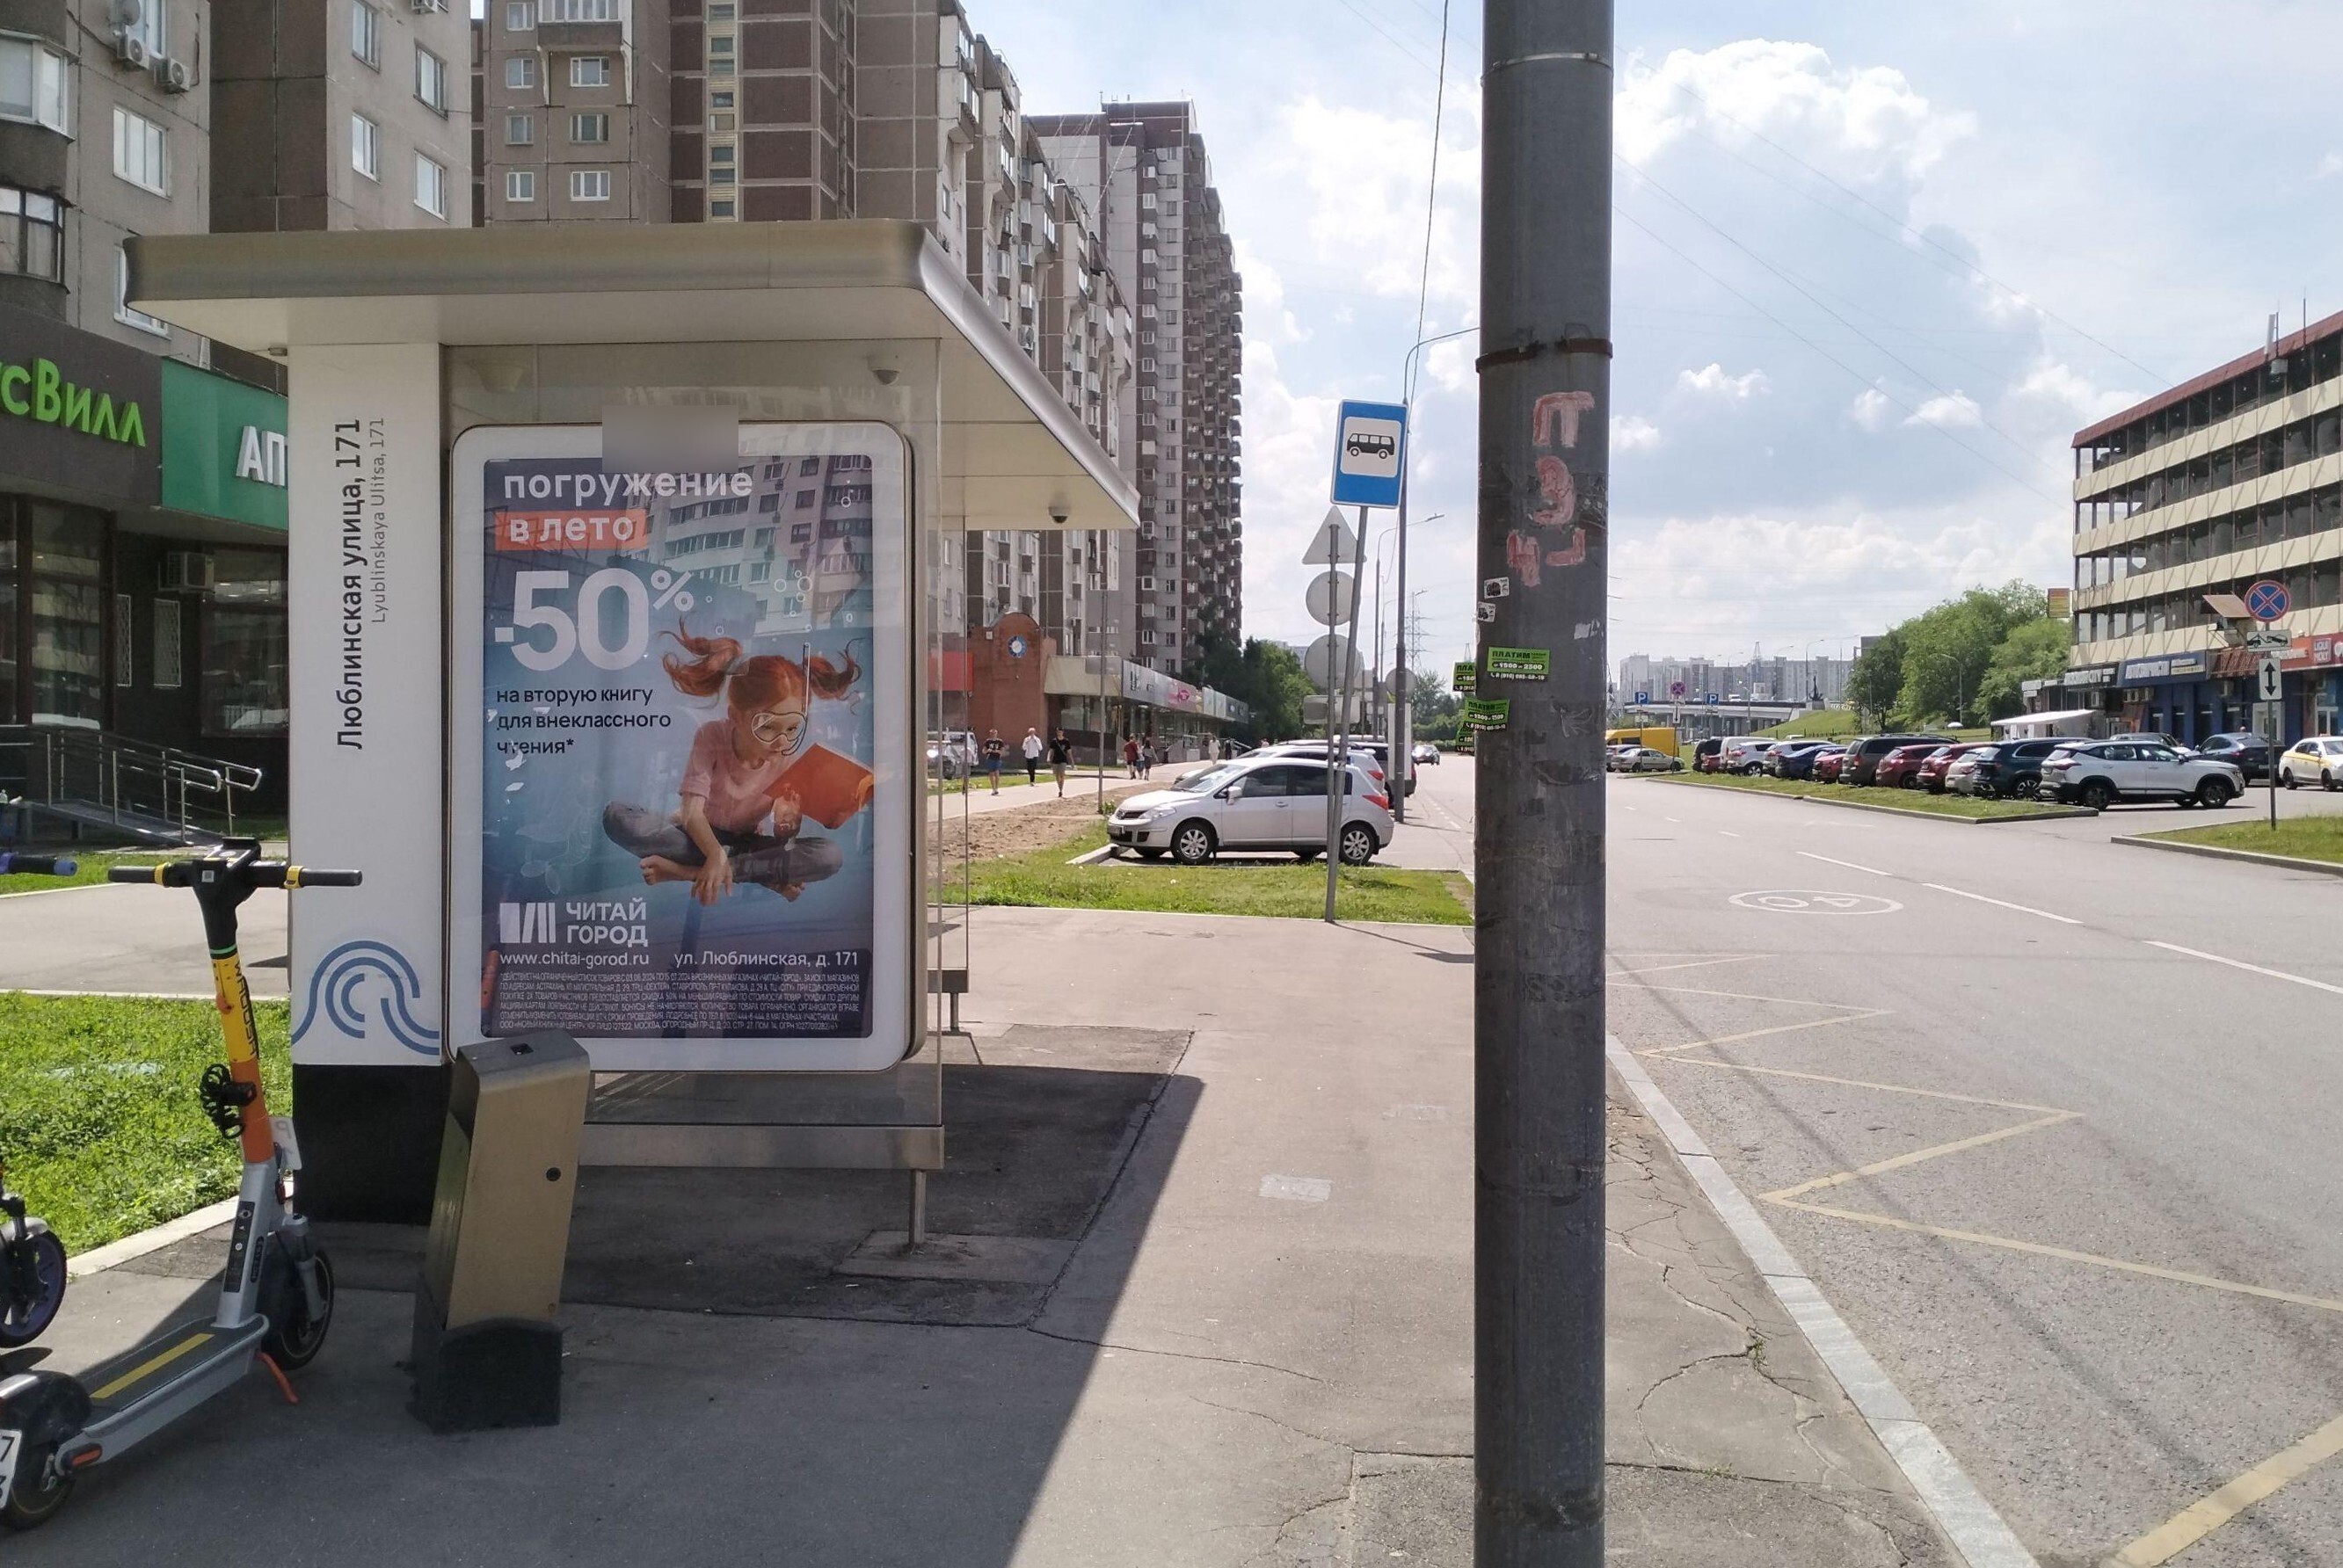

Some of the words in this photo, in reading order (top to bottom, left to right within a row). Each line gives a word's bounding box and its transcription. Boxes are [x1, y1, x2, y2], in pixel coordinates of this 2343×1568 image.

[0, 356, 147, 447] сВилл
[334, 418, 361, 468] 171
[369, 417, 384, 448] 171
[235, 425, 288, 487] АП
[369, 453, 387, 506] Ulitsa,
[504, 471, 753, 506] погружение
[342, 477, 368, 567] улица,
[510, 516, 529, 542] в
[539, 513, 635, 542] лето
[369, 512, 389, 623] Lyublinskaya
[494, 568, 695, 671] -50%
[335, 575, 362, 750] Люблинская
[496, 690, 520, 703] на
[524, 688, 597, 707] вторую
[600, 688, 653, 706] книгу
[496, 715, 532, 731] для
[535, 714, 672, 729] внеклассного
[565, 897, 647, 921] ЧИТАЙ
[566, 925, 649, 948] ГОРОД
[499, 950, 650, 969] www.chitai-gorod.ru
[673, 952, 698, 969] ул.
[702, 950, 811, 967] Люблинская,
[836, 951, 858, 966] 171
